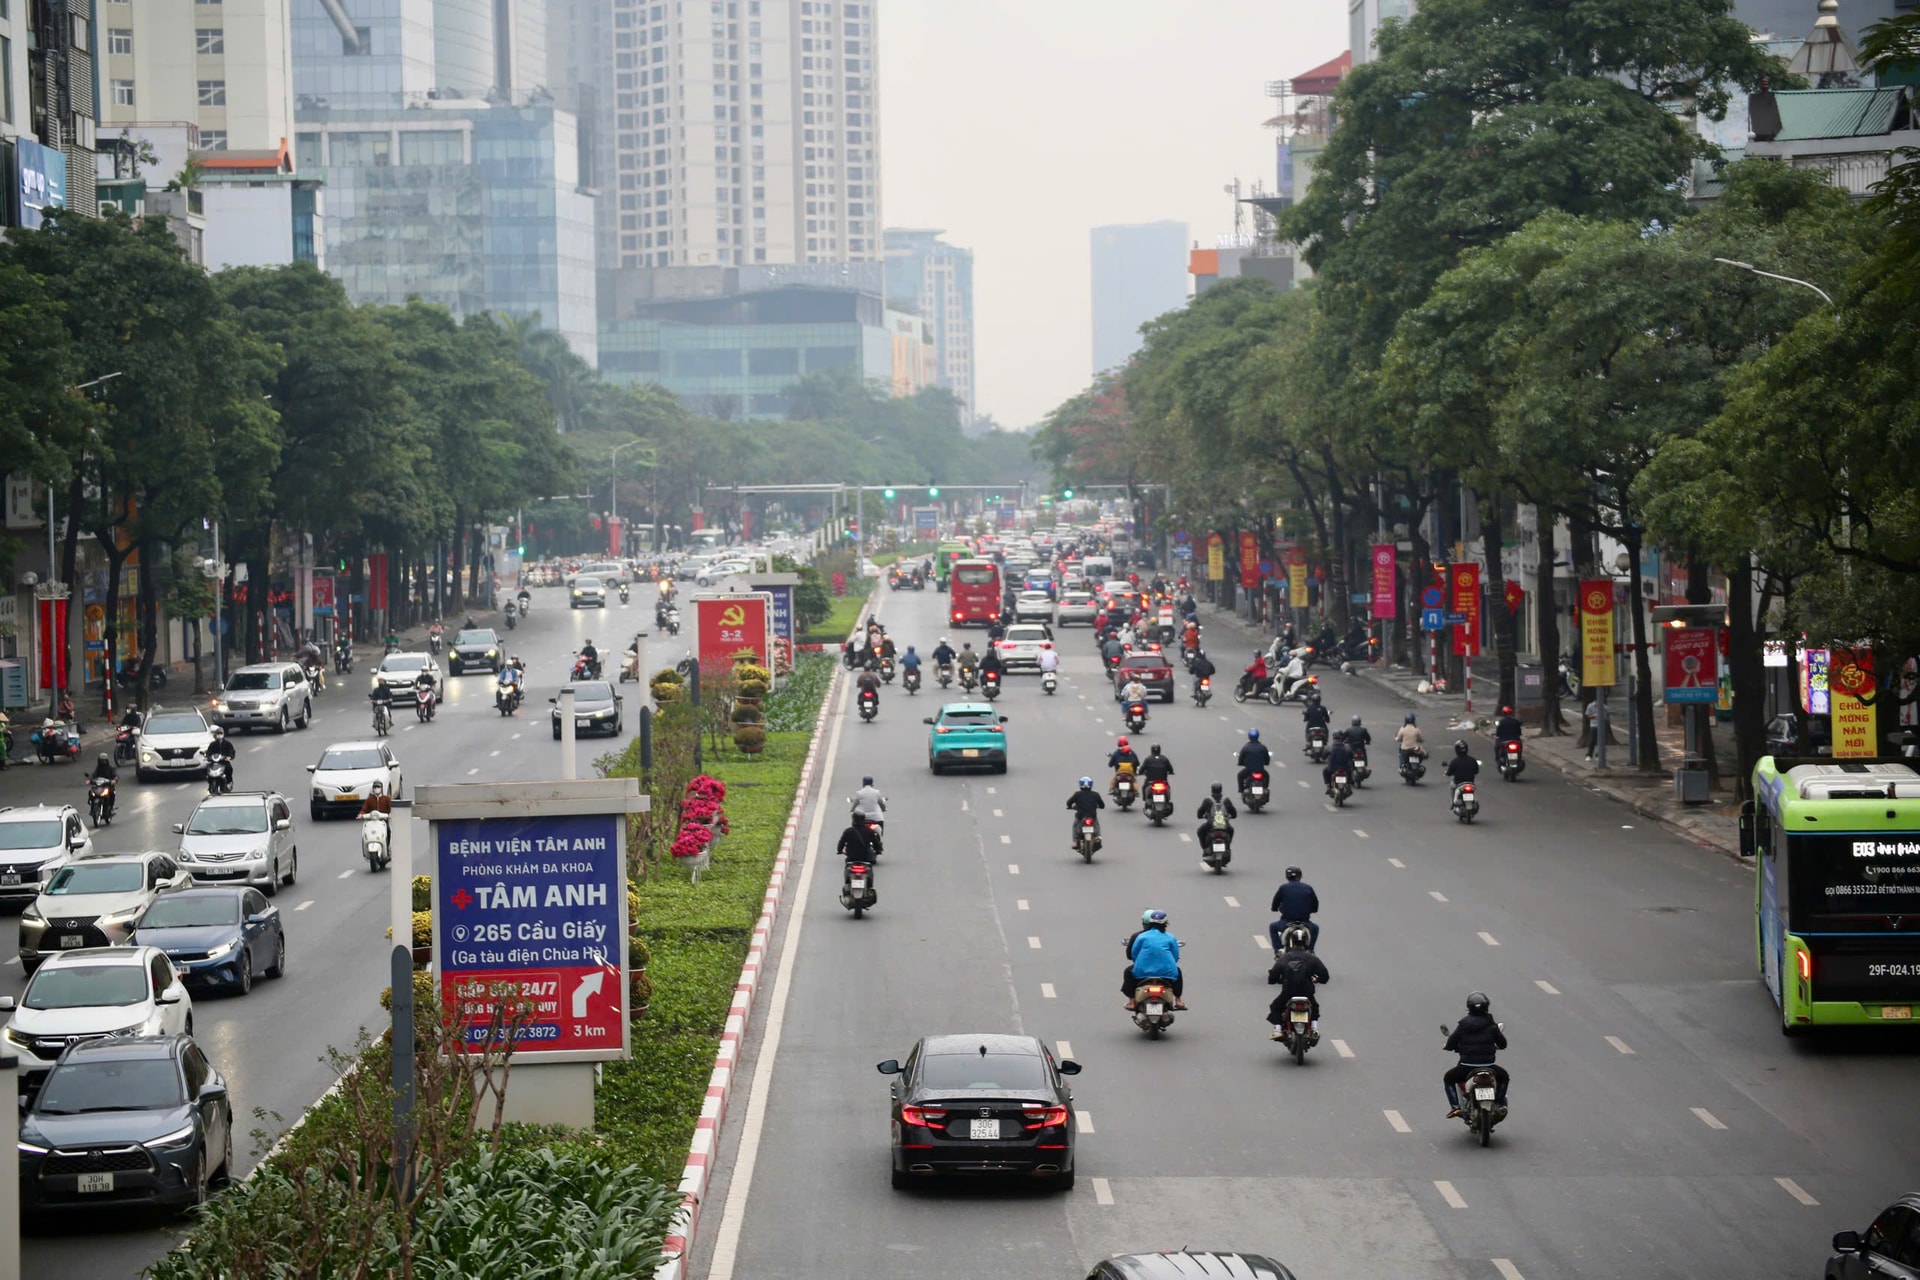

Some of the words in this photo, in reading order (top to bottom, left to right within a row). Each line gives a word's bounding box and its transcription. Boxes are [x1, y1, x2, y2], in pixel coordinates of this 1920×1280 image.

[721, 629, 742, 638] 3-2
[450, 839, 491, 858] BỆNH
[495, 837, 532, 856] VIỆN
[535, 836, 568, 852] TÂM
[573, 837, 606, 851] ANH
[1852, 841, 1876, 857] E03
[462, 863, 503, 876] PHÒNG
[506, 861, 539, 875] KHÁM
[543, 863, 558, 874] ĐA
[561, 862, 594, 873] KHOA
[475, 882, 537, 909] TÂM
[544, 883, 607, 907] ANH
[1835, 885, 1852, 895] 0866
[1852, 885, 1865, 895] 355
[1865, 885, 1877, 894] 222
[474, 923, 512, 942] 265
[518, 920, 557, 940] Cầu
[562, 919, 607, 942] Giấy
[451, 950, 477, 966] (Ga
[480, 949, 504, 963] tàu
[507, 949, 539, 965] điện
[542, 947, 579, 961] Chùa
[521, 981, 557, 996] 24/7
[528, 1026, 556, 1038] 3872
[573, 1024, 582, 1037] 3
[585, 1024, 606, 1037] km
